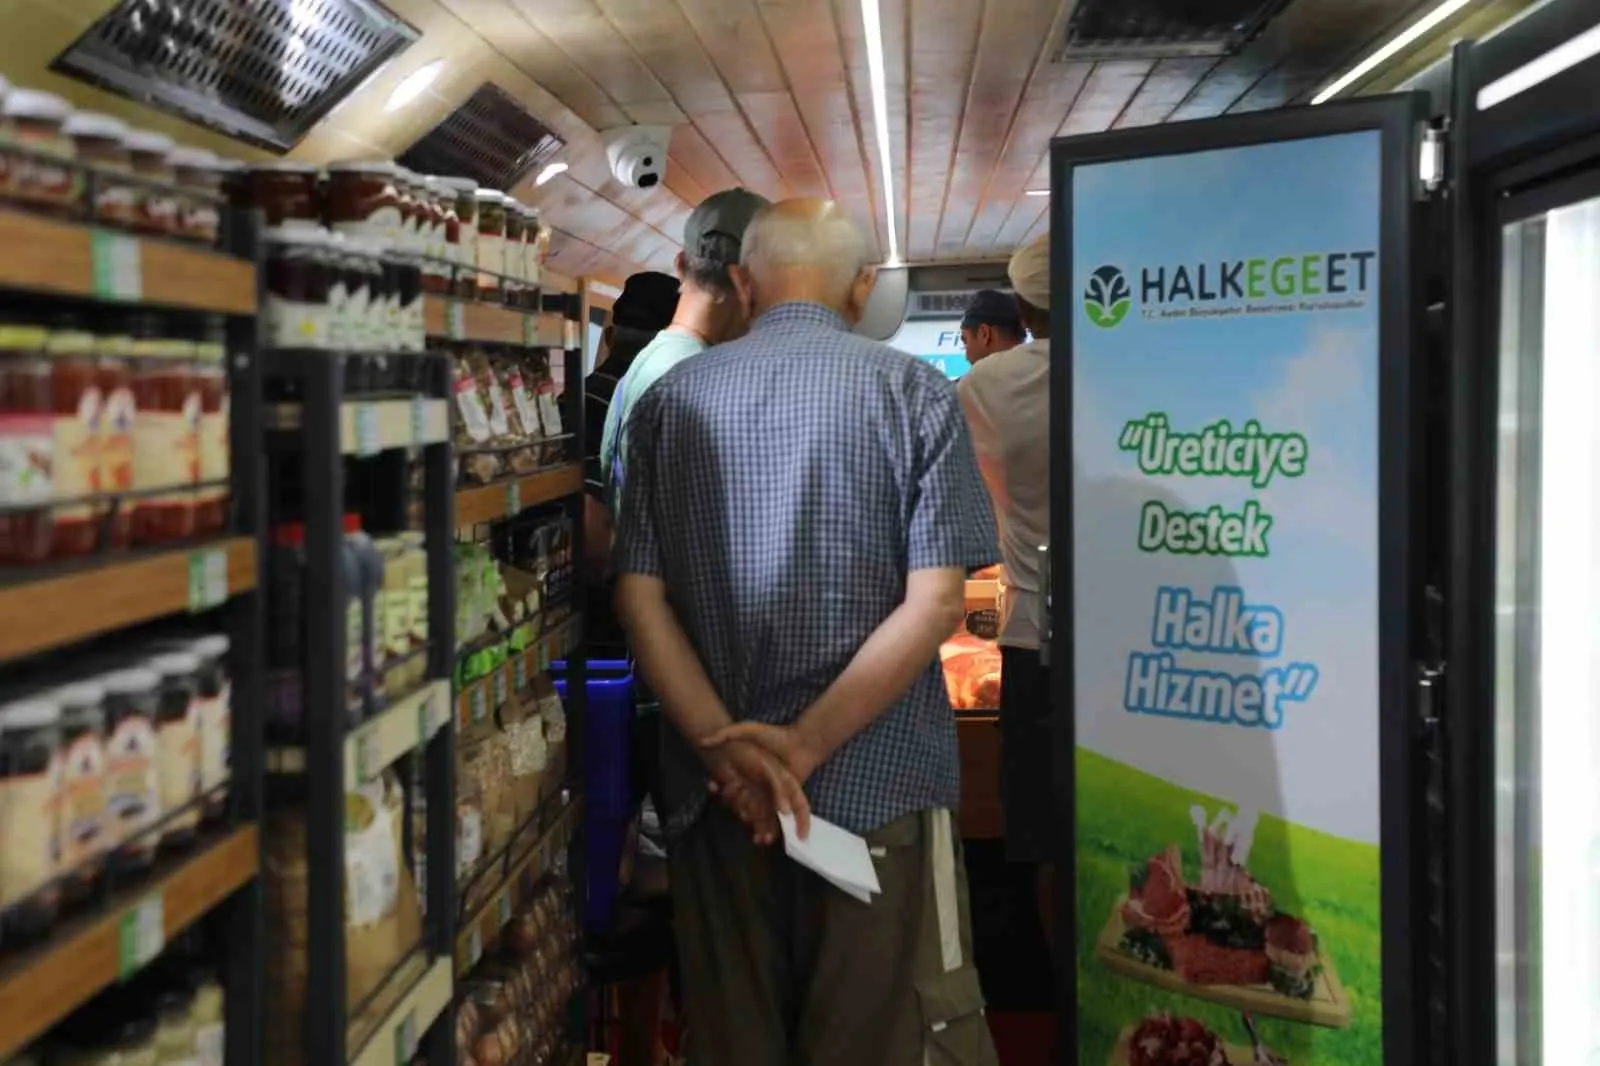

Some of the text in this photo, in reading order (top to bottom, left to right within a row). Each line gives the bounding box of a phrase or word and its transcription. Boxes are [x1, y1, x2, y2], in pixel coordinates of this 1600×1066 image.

[1141, 251, 1376, 304] HALKEGEET
[1138, 500, 1272, 557] Destek
[1152, 586, 1284, 656] Halka
